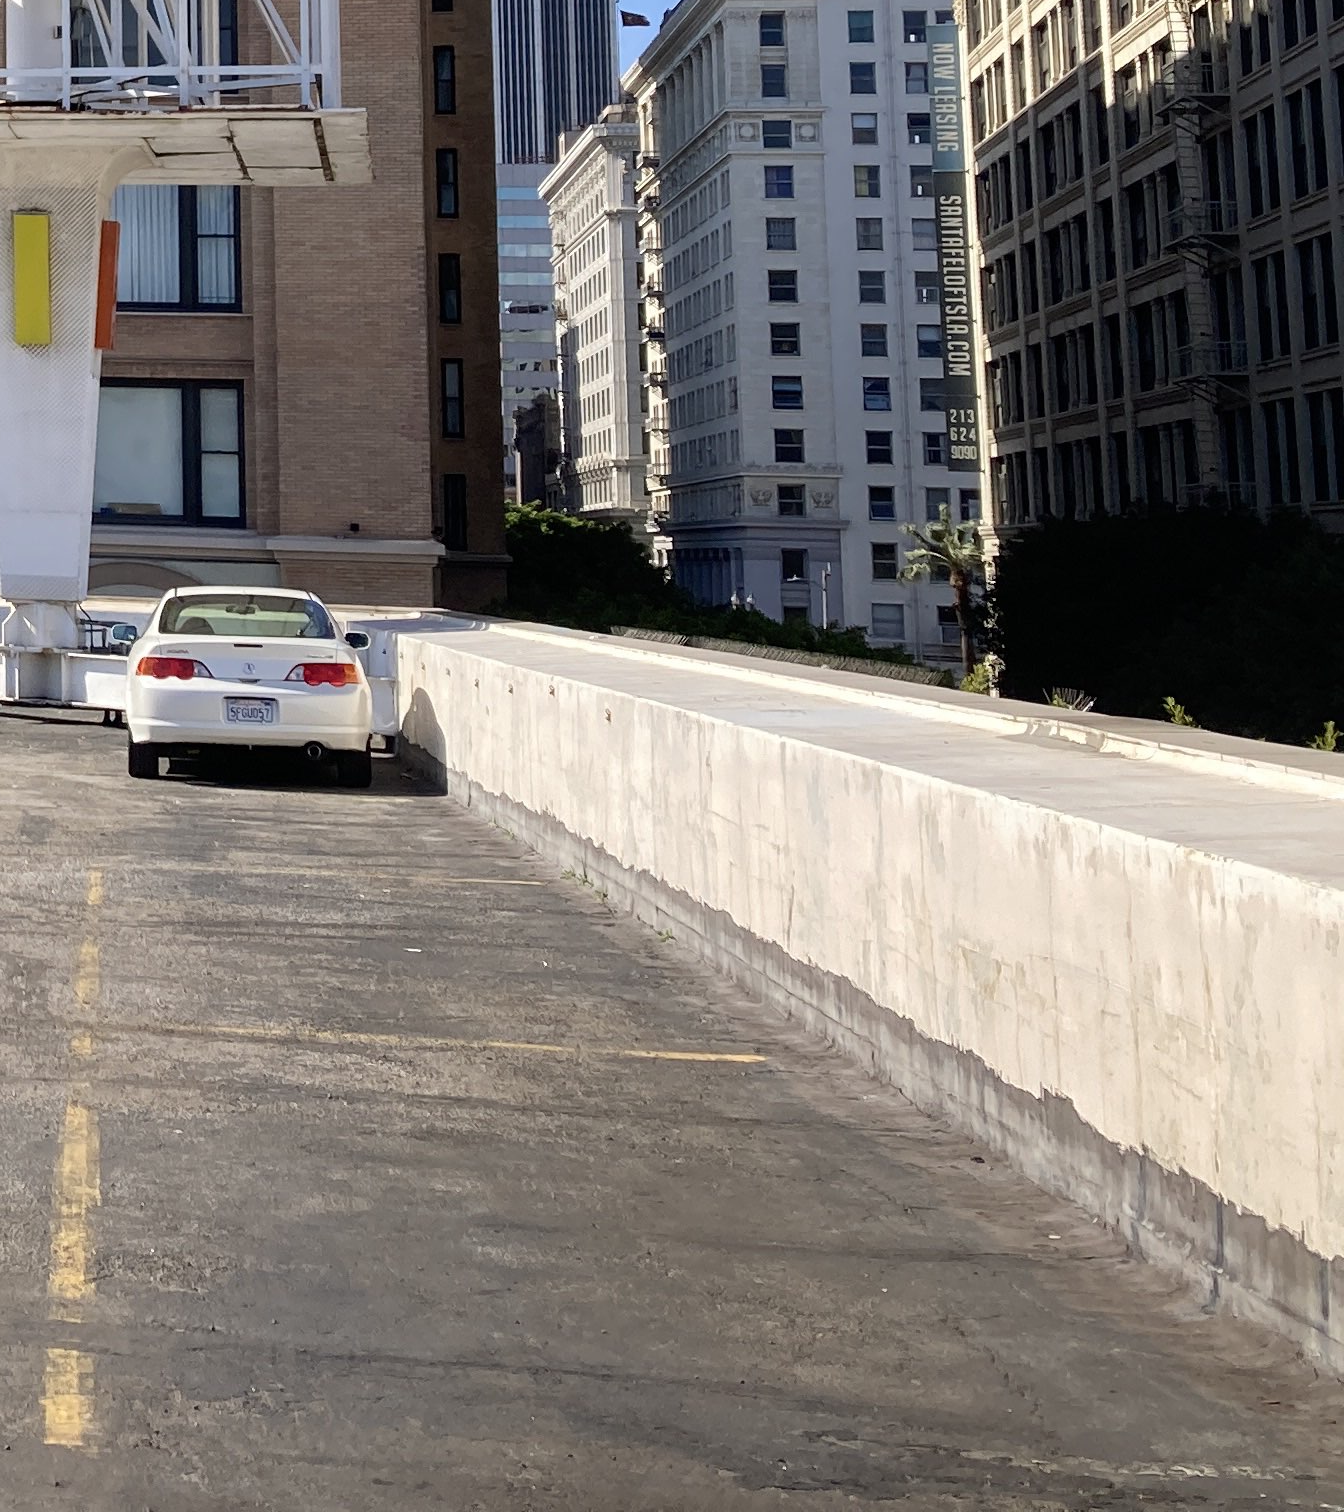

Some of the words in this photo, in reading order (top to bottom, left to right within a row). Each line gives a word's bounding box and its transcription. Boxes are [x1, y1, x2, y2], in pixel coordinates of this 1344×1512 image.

[932, 43, 956, 80] NOW
[934, 86, 959, 152] LEASING
[939, 195, 972, 377] SANTAFELOFTSLA.COM
[949, 408, 975, 424] 213
[950, 427, 977, 442] 624
[951, 445, 978, 460] 9090
